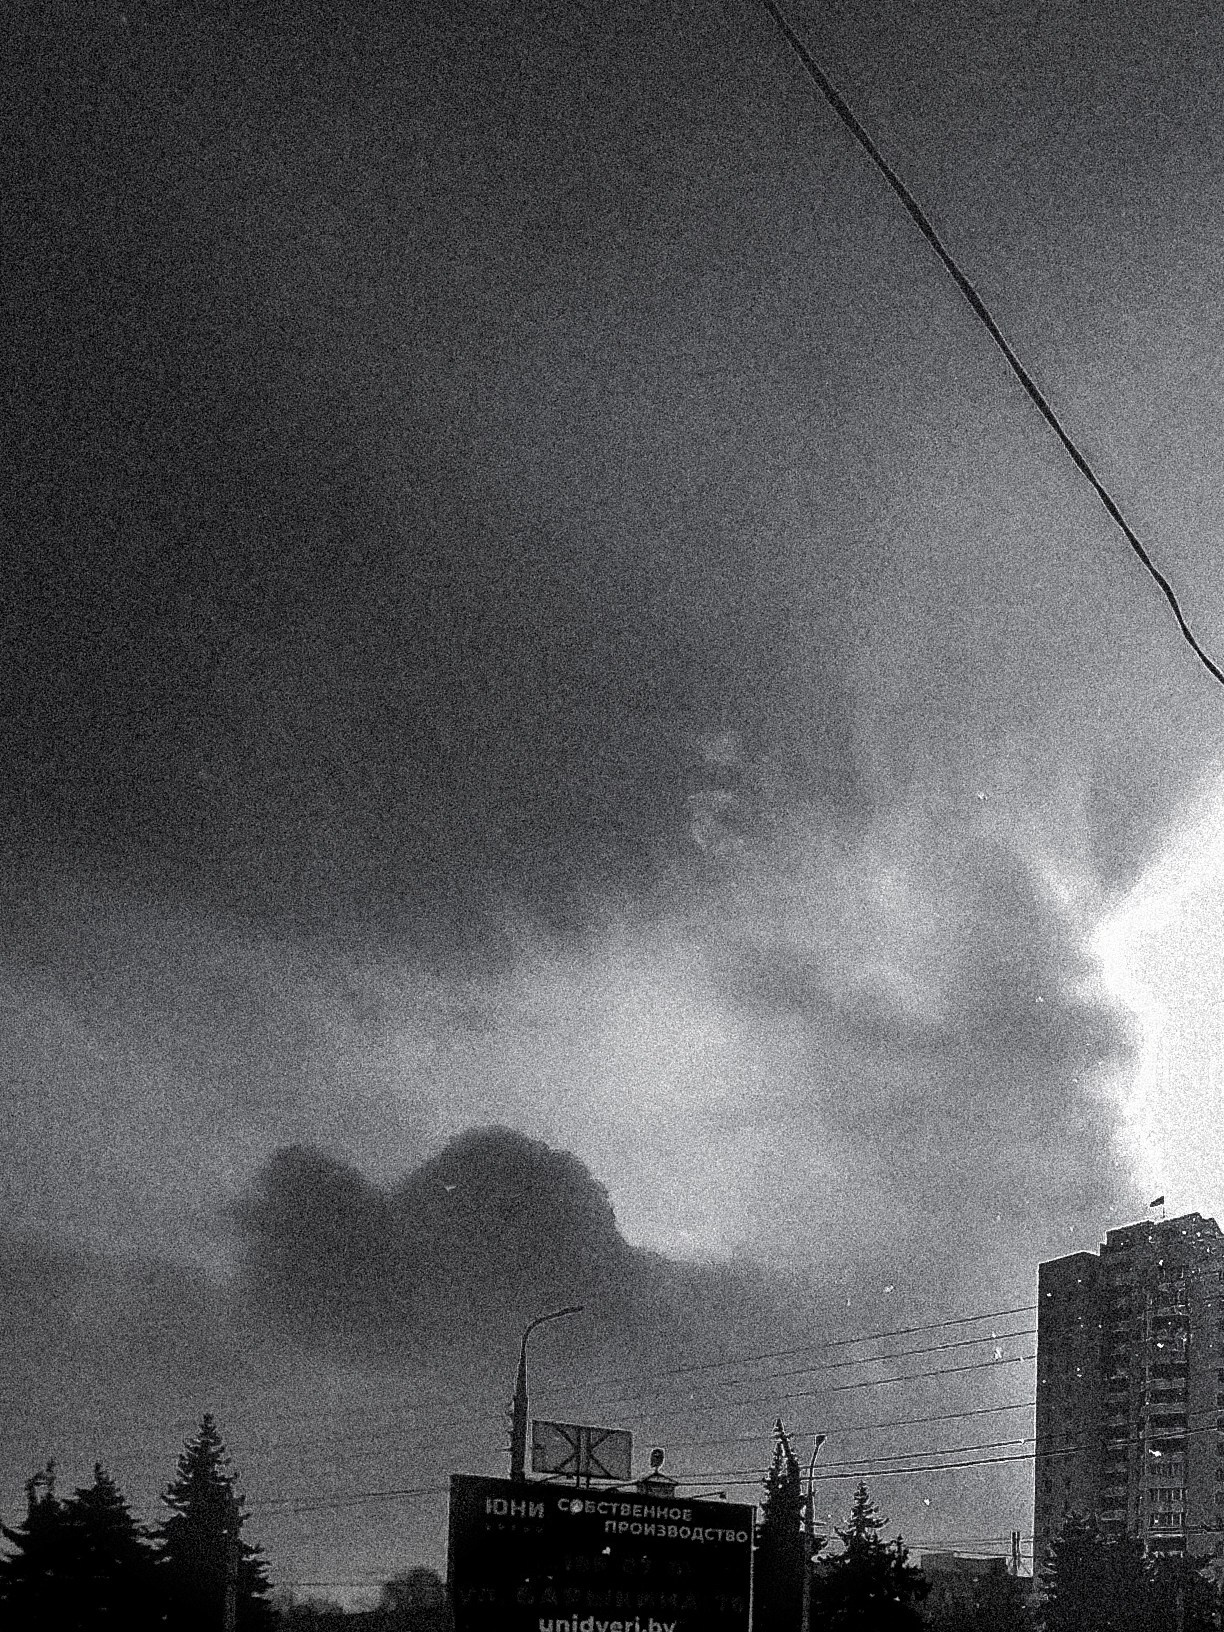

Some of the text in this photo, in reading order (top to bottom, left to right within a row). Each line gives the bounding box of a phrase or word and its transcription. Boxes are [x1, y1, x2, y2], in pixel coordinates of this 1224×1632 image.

[485, 1497, 545, 1519] ЮНИ
[557, 1498, 693, 1522] СОБСТВЕННОЕ
[604, 1520, 748, 1543] ПРОИЗВОДСТВО
